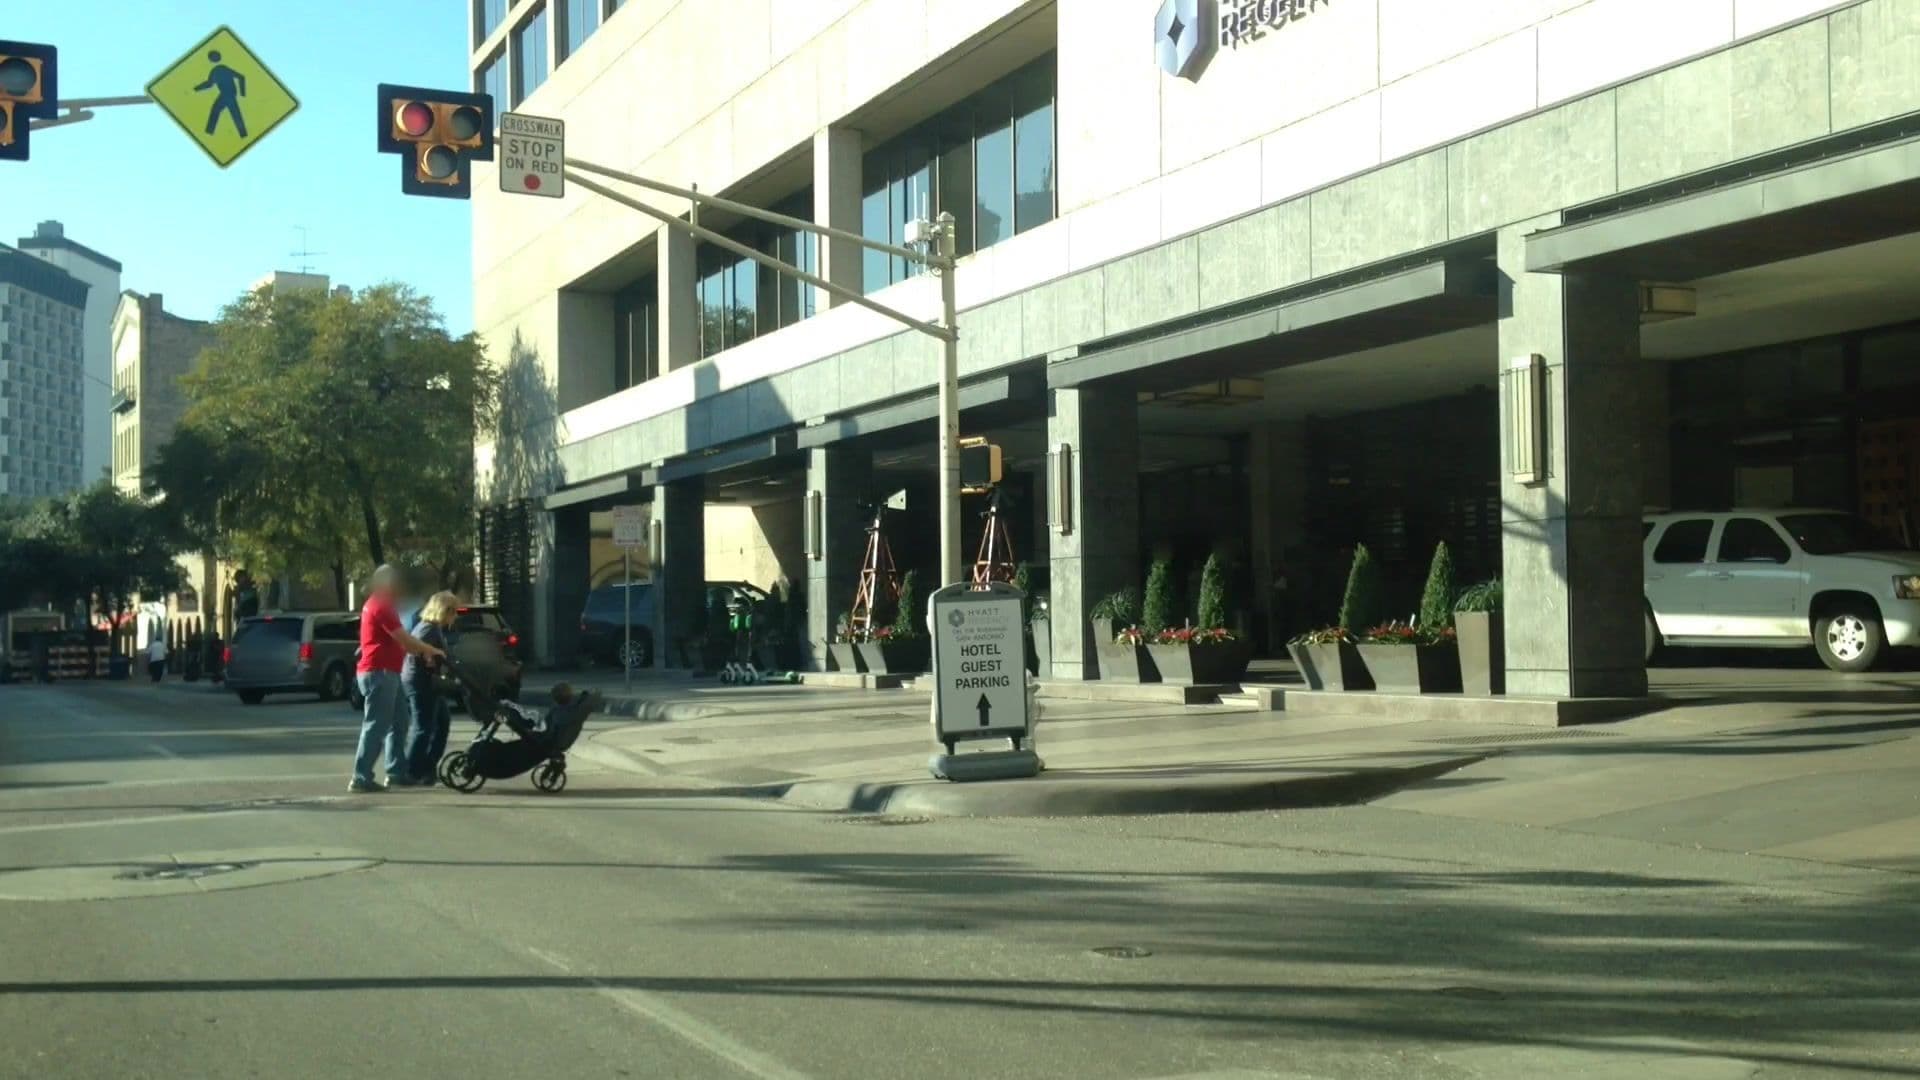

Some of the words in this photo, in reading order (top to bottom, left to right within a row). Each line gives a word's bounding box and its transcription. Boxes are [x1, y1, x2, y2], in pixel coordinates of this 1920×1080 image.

[503, 118, 561, 136] CROSSWALK
[509, 139, 556, 160] STOP
[505, 157, 524, 169] ON
[532, 160, 559, 174] RED
[968, 608, 1000, 616] HYATT
[961, 644, 1001, 656] HOTEL
[961, 660, 1002, 673] GUEST
[955, 676, 1010, 689] PARKING
